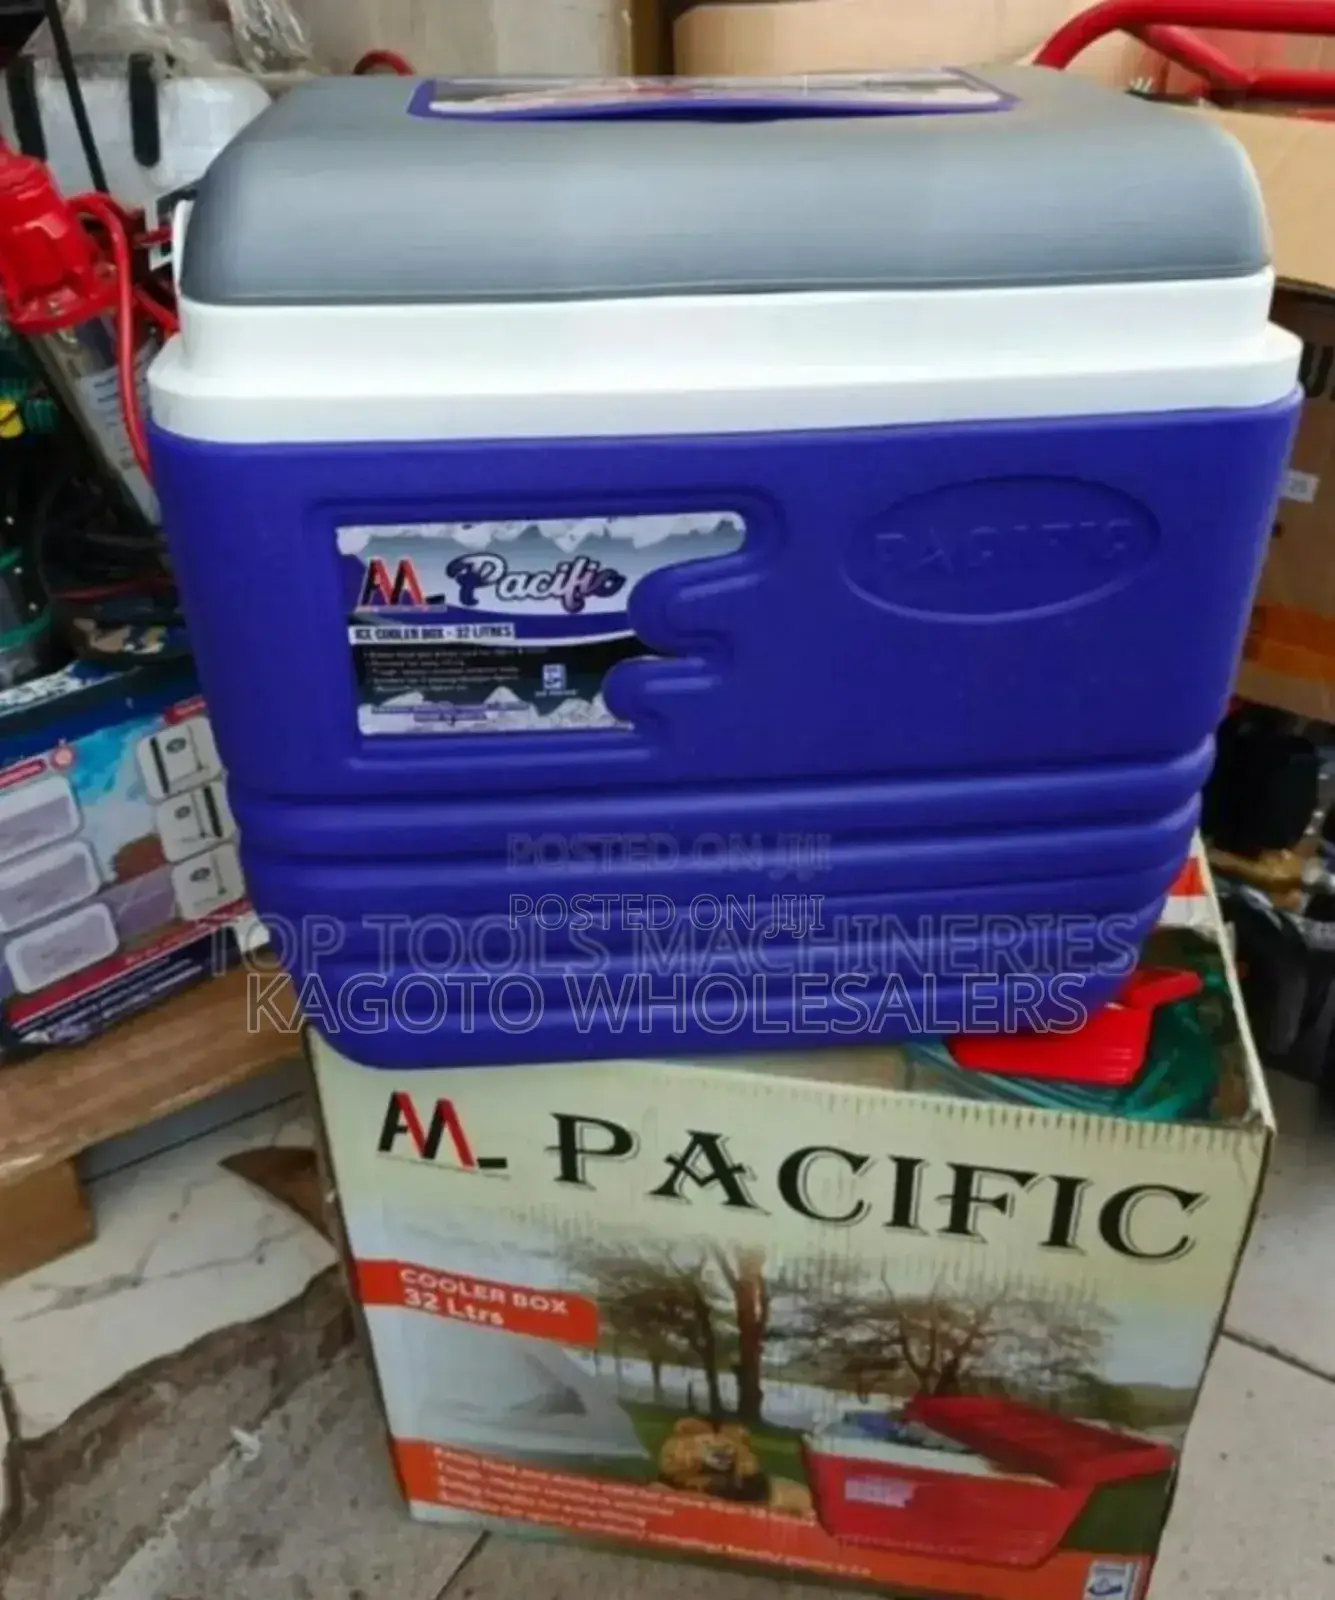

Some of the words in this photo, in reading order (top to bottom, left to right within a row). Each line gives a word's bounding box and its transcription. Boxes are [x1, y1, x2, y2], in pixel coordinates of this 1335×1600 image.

[446, 552, 626, 613] Pacific
[355, 628, 372, 640] ICE
[375, 627, 420, 640] COOLER
[421, 626, 444, 640] BOX
[456, 626, 470, 639] 32
[473, 625, 513, 638] LITRES
[545, 1111, 1210, 1266] PACIFIC
[400, 1268, 506, 1305] COOLER
[511, 1292, 568, 1318] BOX
[404, 1287, 439, 1313] 32
[446, 1297, 505, 1326] Ltrs
